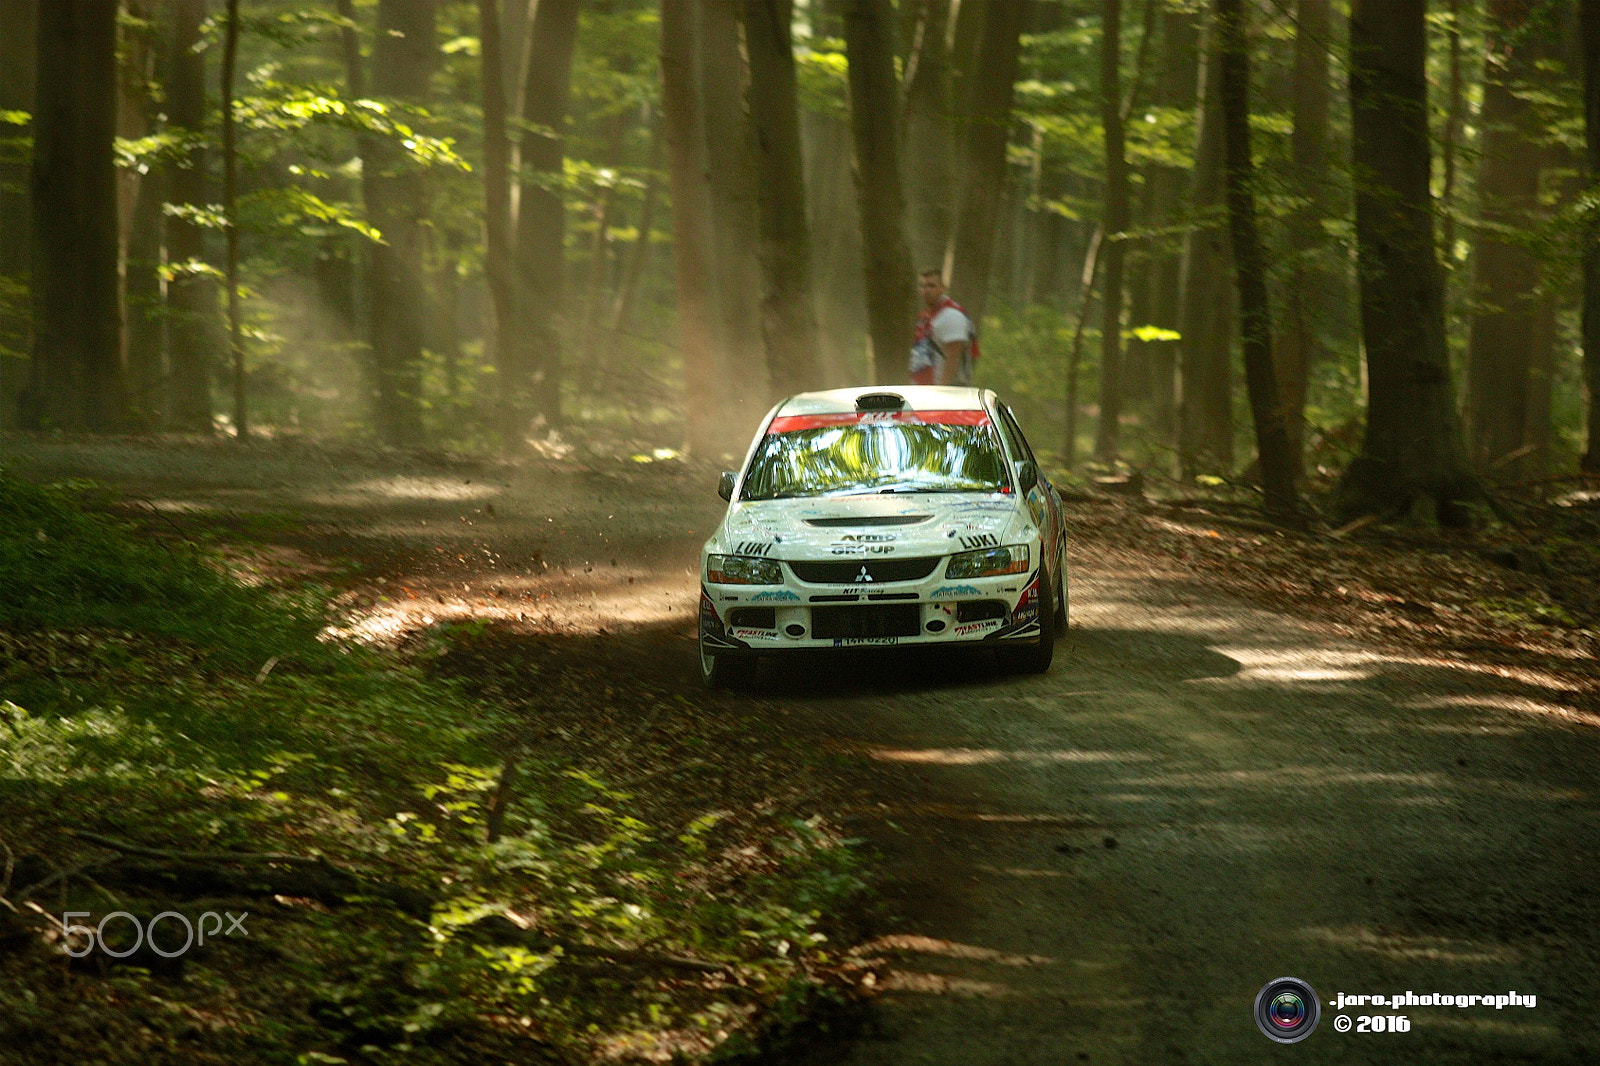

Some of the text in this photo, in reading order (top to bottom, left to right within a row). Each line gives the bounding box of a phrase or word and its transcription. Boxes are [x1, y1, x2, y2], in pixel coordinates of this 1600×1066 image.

[735, 541, 773, 556] LUKI
[958, 533, 998, 549] LUKI
[831, 545, 895, 555] GROUP
